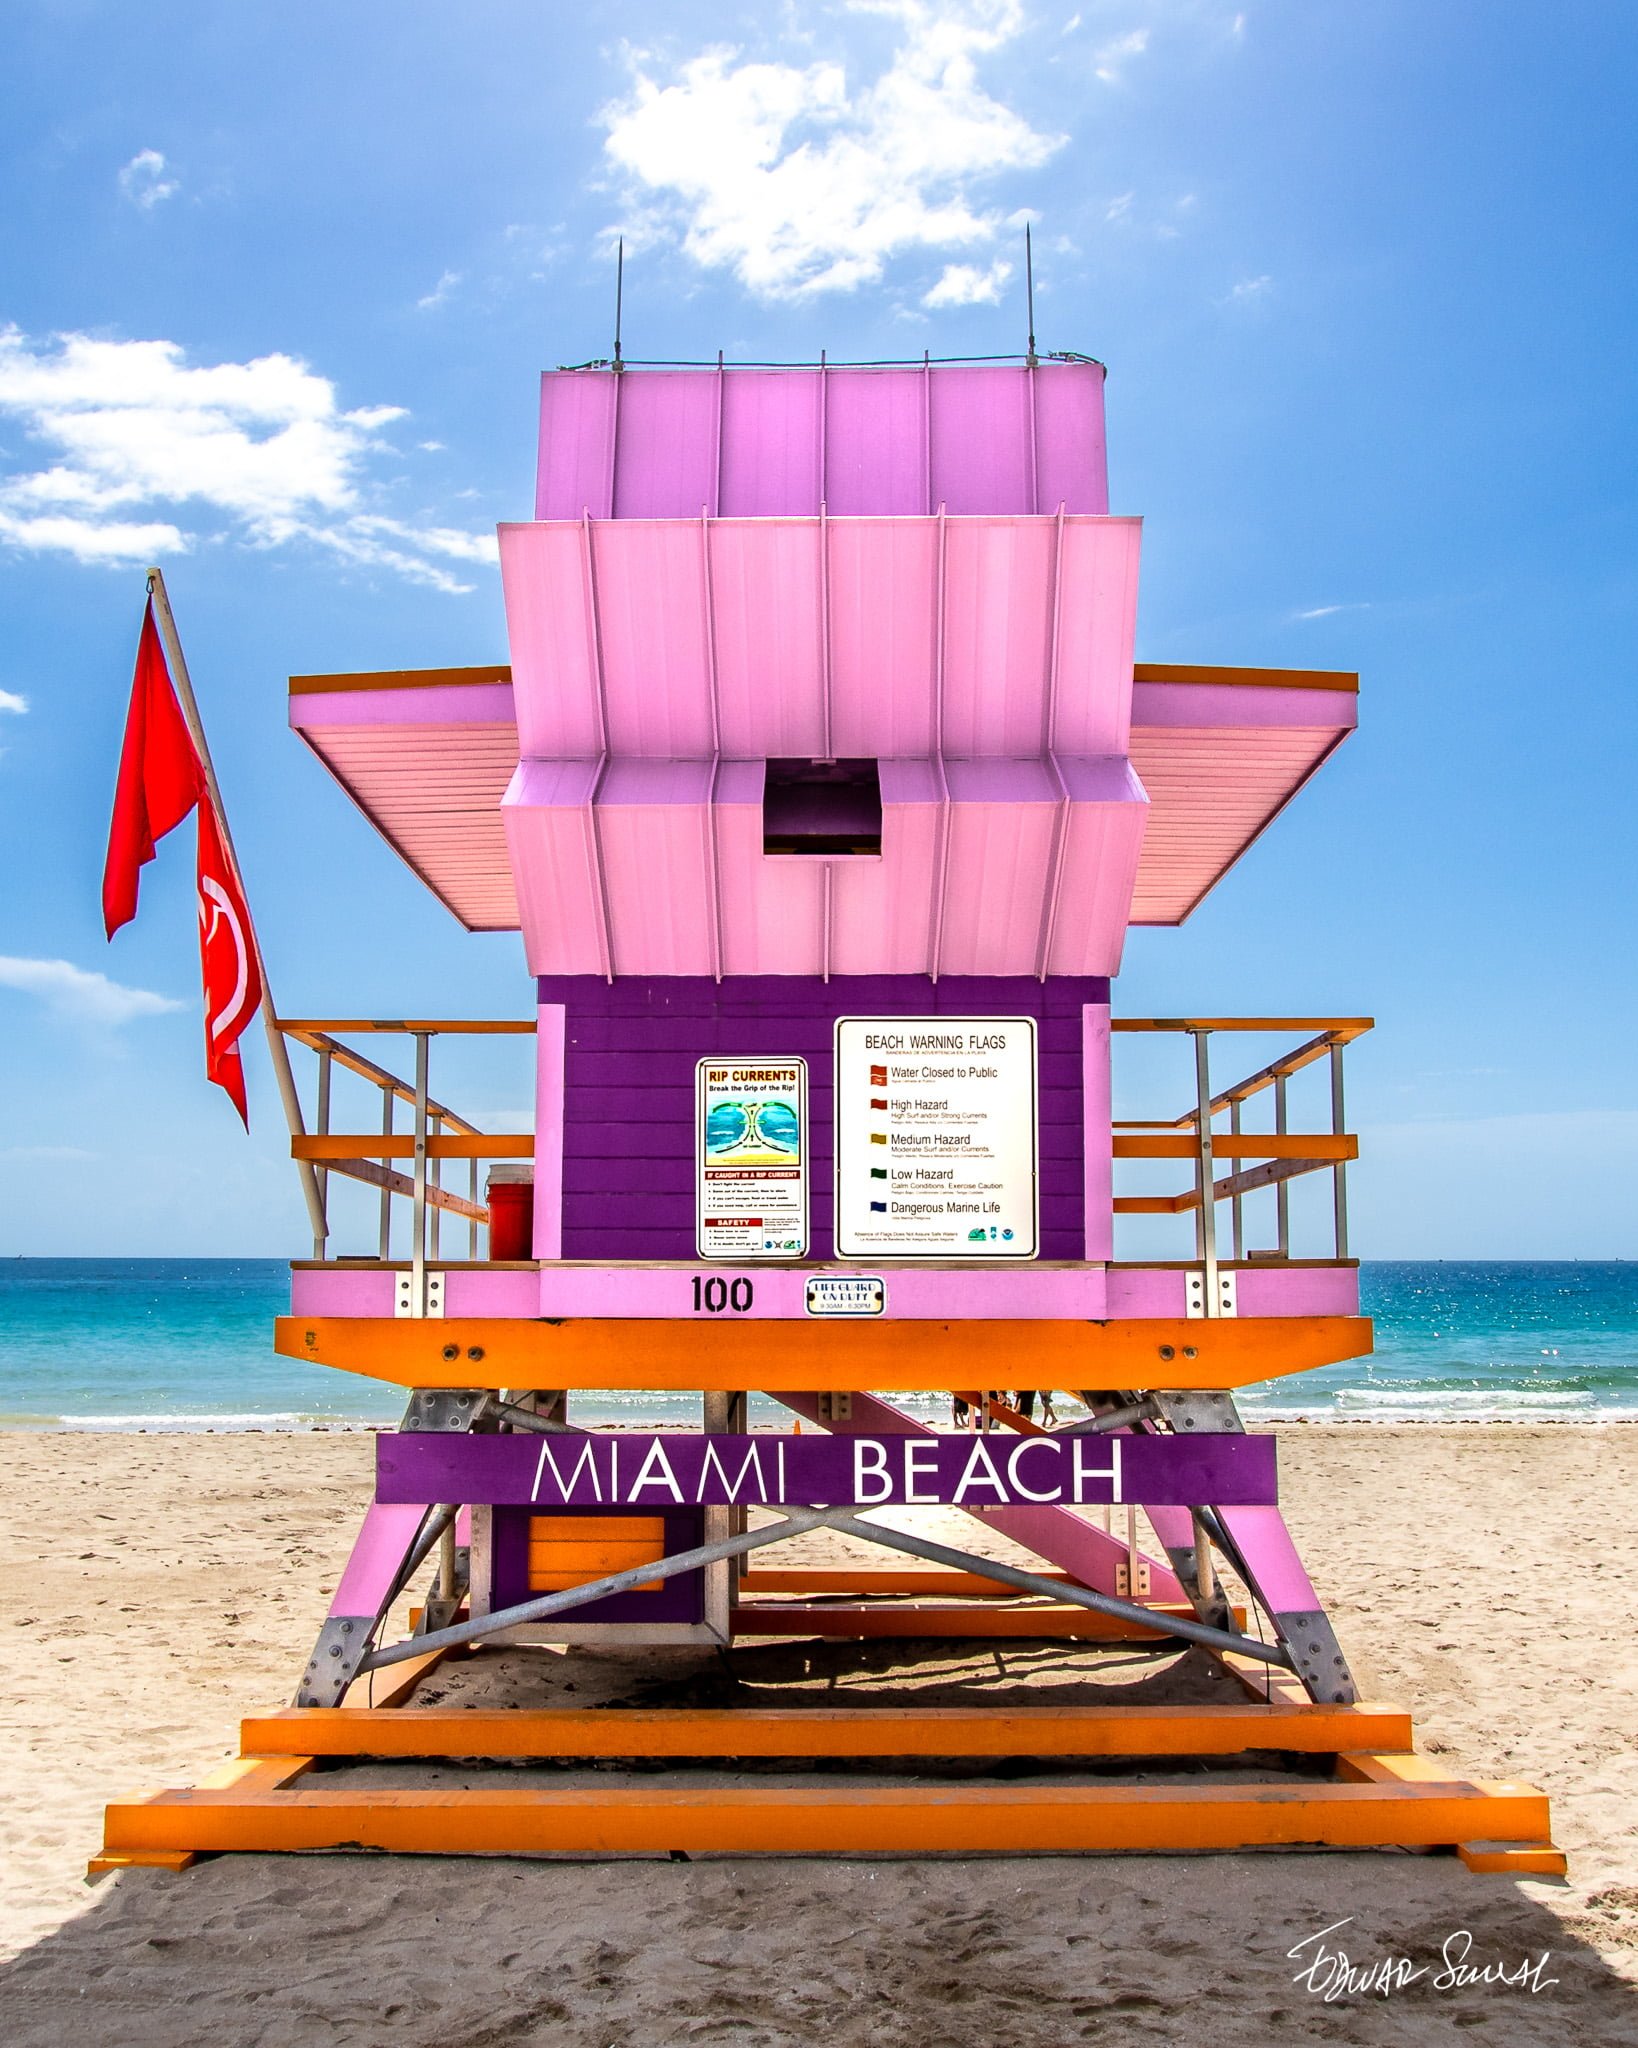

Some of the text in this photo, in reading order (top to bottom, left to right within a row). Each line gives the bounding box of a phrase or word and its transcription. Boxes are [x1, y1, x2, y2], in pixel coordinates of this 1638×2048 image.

[865, 1035, 1006, 1049] BEACH WARNING FLAGS
[709, 1071, 796, 1081] RIP CURRENTS
[891, 1066, 998, 1078] Water Closed to Public
[891, 1099, 948, 1112] High Hazard
[891, 1134, 970, 1144] Medium Hazard
[891, 1169, 953, 1179] Low Hazard
[891, 1202, 1000, 1215] Dangerous Marine Life
[691, 1276, 753, 1312] 100
[823, 1293, 868, 1301] ON DUTY
[530, 1436, 1122, 1504] MIAMI BEACH
